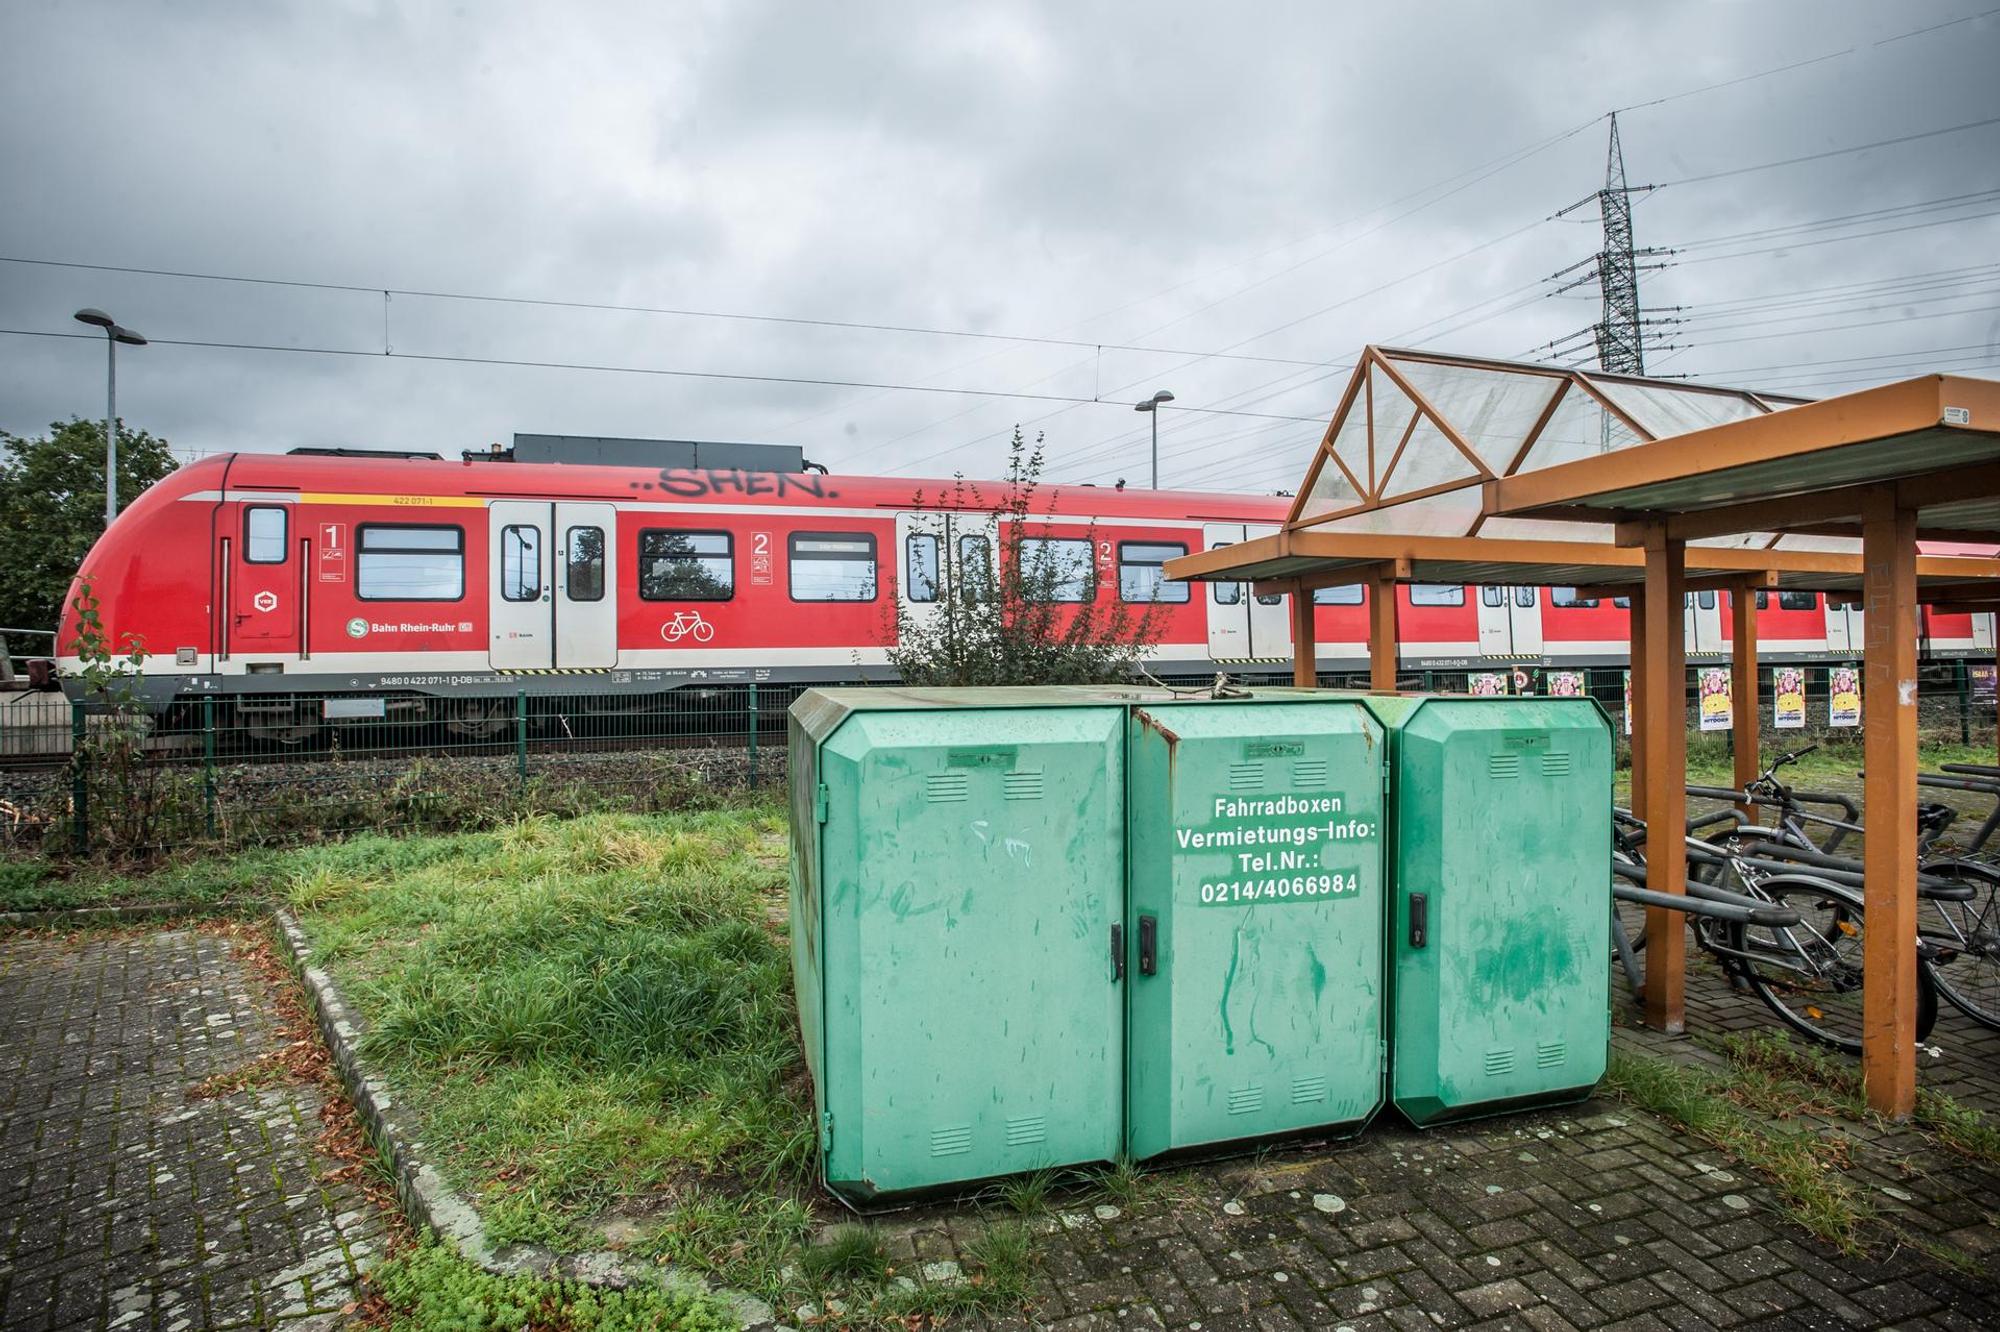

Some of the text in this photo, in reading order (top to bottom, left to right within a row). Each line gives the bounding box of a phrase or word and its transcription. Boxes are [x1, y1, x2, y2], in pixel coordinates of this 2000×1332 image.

[393, 497, 410, 505] 422
[325, 525, 337, 548] 1
[754, 534, 768, 554] 2
[1100, 542, 1112, 561] 2
[372, 623, 398, 632] Bahn
[400, 623, 456, 632] Rhein-Ruhr
[410, 677, 426, 685] 422
[428, 676, 450, 685] 071-1
[1215, 796, 1341, 818] Fahrradboxen
[1176, 820, 1376, 848] Vermietungs-Info:
[1238, 851, 1318, 872] Tel.Nr.:
[1201, 874, 1357, 903] 0214/4066984
